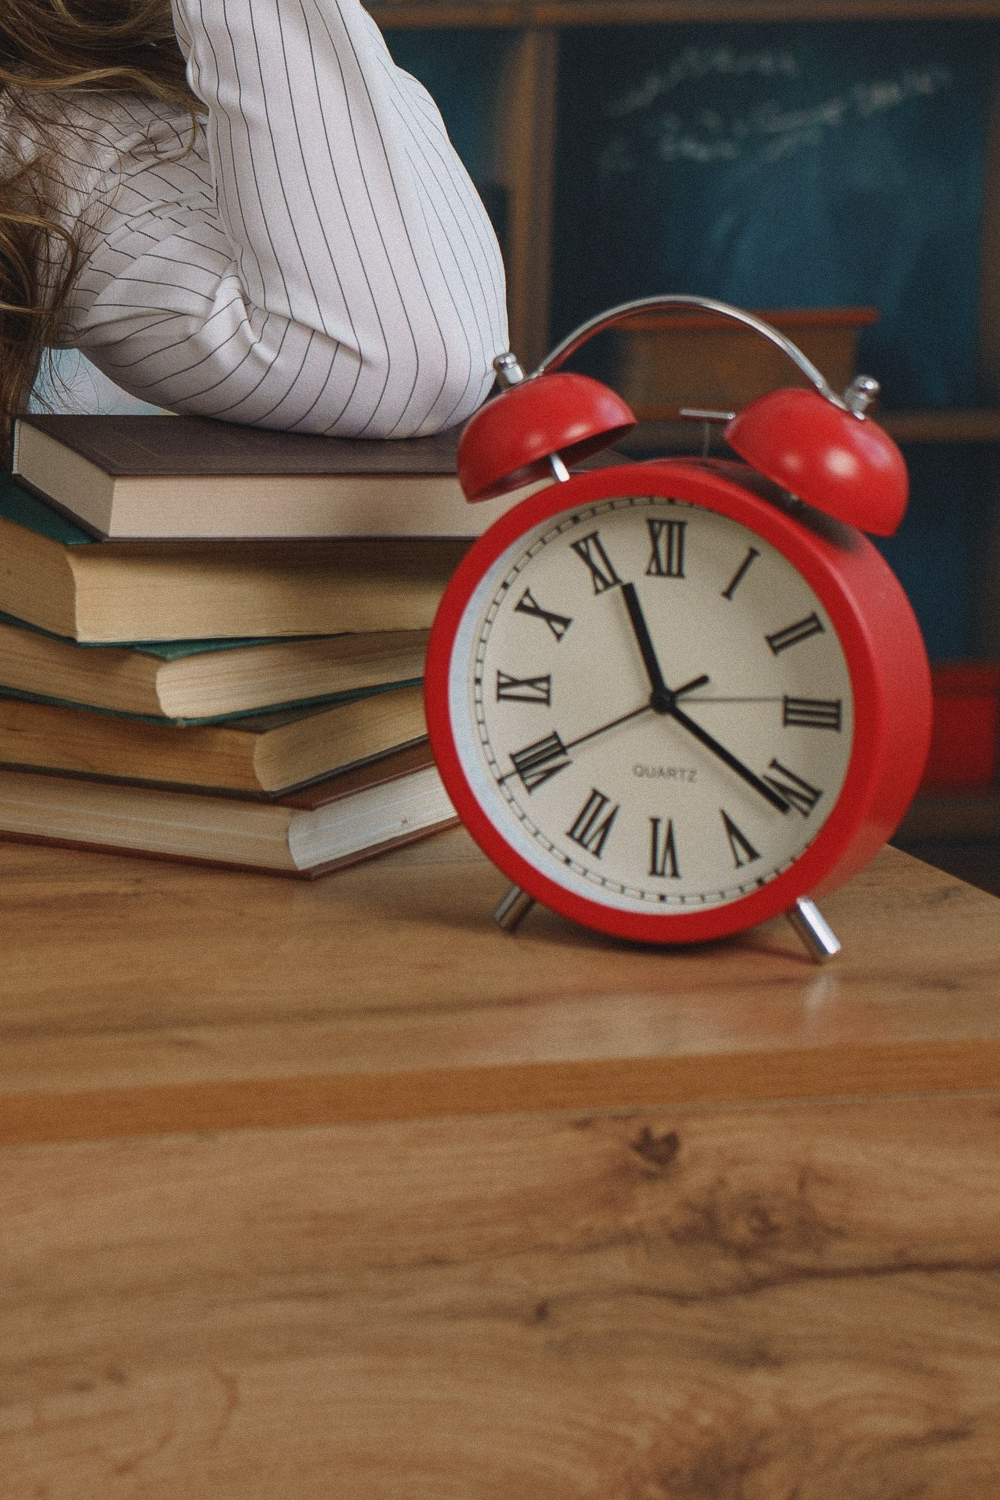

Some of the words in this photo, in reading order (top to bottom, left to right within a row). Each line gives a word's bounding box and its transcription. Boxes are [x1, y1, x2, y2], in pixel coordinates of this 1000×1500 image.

[570, 531, 624, 596] XI
[646, 518, 687, 579] XII
[721, 546, 761, 600] I
[514, 588, 573, 642] X
[764, 611, 826, 656] II
[497, 669, 552, 708] IX
[782, 694, 842, 733] III
[509, 731, 573, 795] VIII
[632, 762, 698, 784] QUARTZ
[762, 758, 823, 819] IV
[566, 788, 620, 860] VII
[649, 817, 682, 878] VI
[719, 808, 761, 869] V
